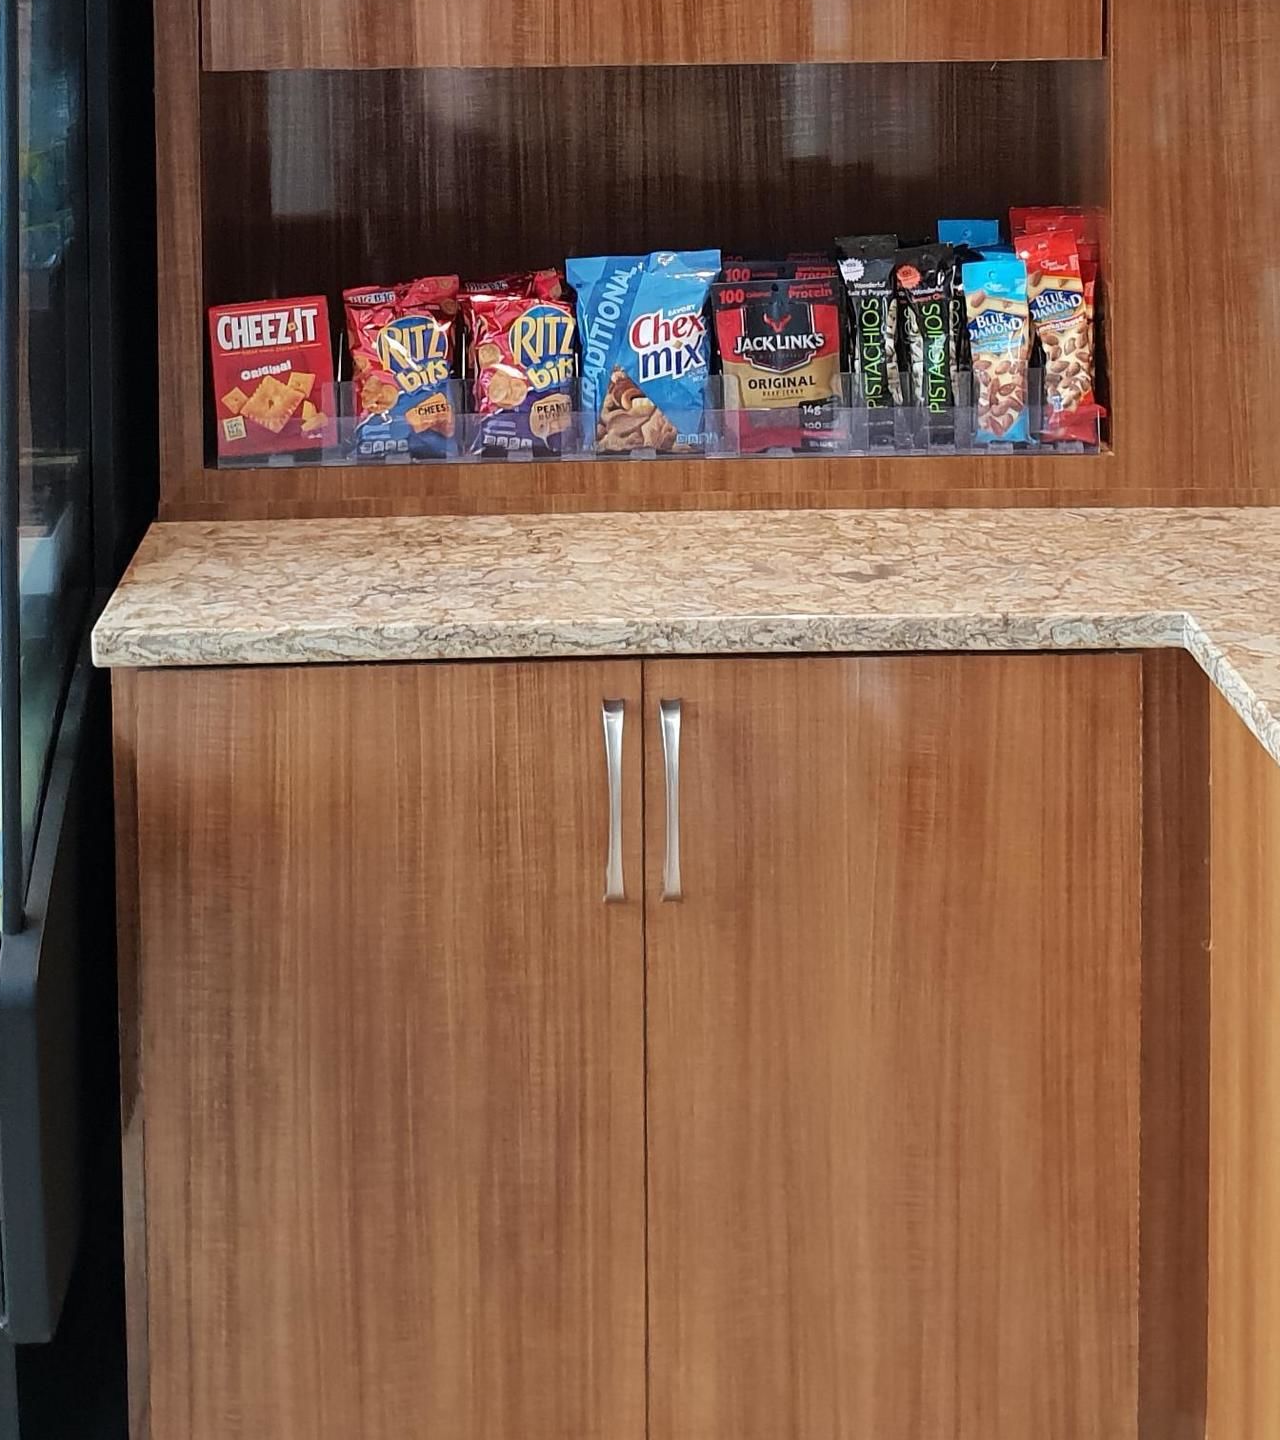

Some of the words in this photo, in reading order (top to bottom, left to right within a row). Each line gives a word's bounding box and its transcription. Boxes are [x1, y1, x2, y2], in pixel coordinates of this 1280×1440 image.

[724, 268, 751, 282] 100
[719, 288, 745, 304] 100
[1035, 290, 1065, 308] BLUE
[630, 310, 705, 351] Chex
[975, 313, 1007, 330] BLUE
[381, 324, 438, 372] RITZ
[511, 316, 576, 365] RITZ
[733, 335, 775, 355] JACK
[776, 332, 826, 351] LINK'S
[860, 297, 884, 410] PISTACHIOS
[921, 302, 949, 415] PISTACHIOS
[397, 360, 449, 393] bits
[530, 360, 575, 392] bits
[748, 374, 818, 391] ORIGINAL
